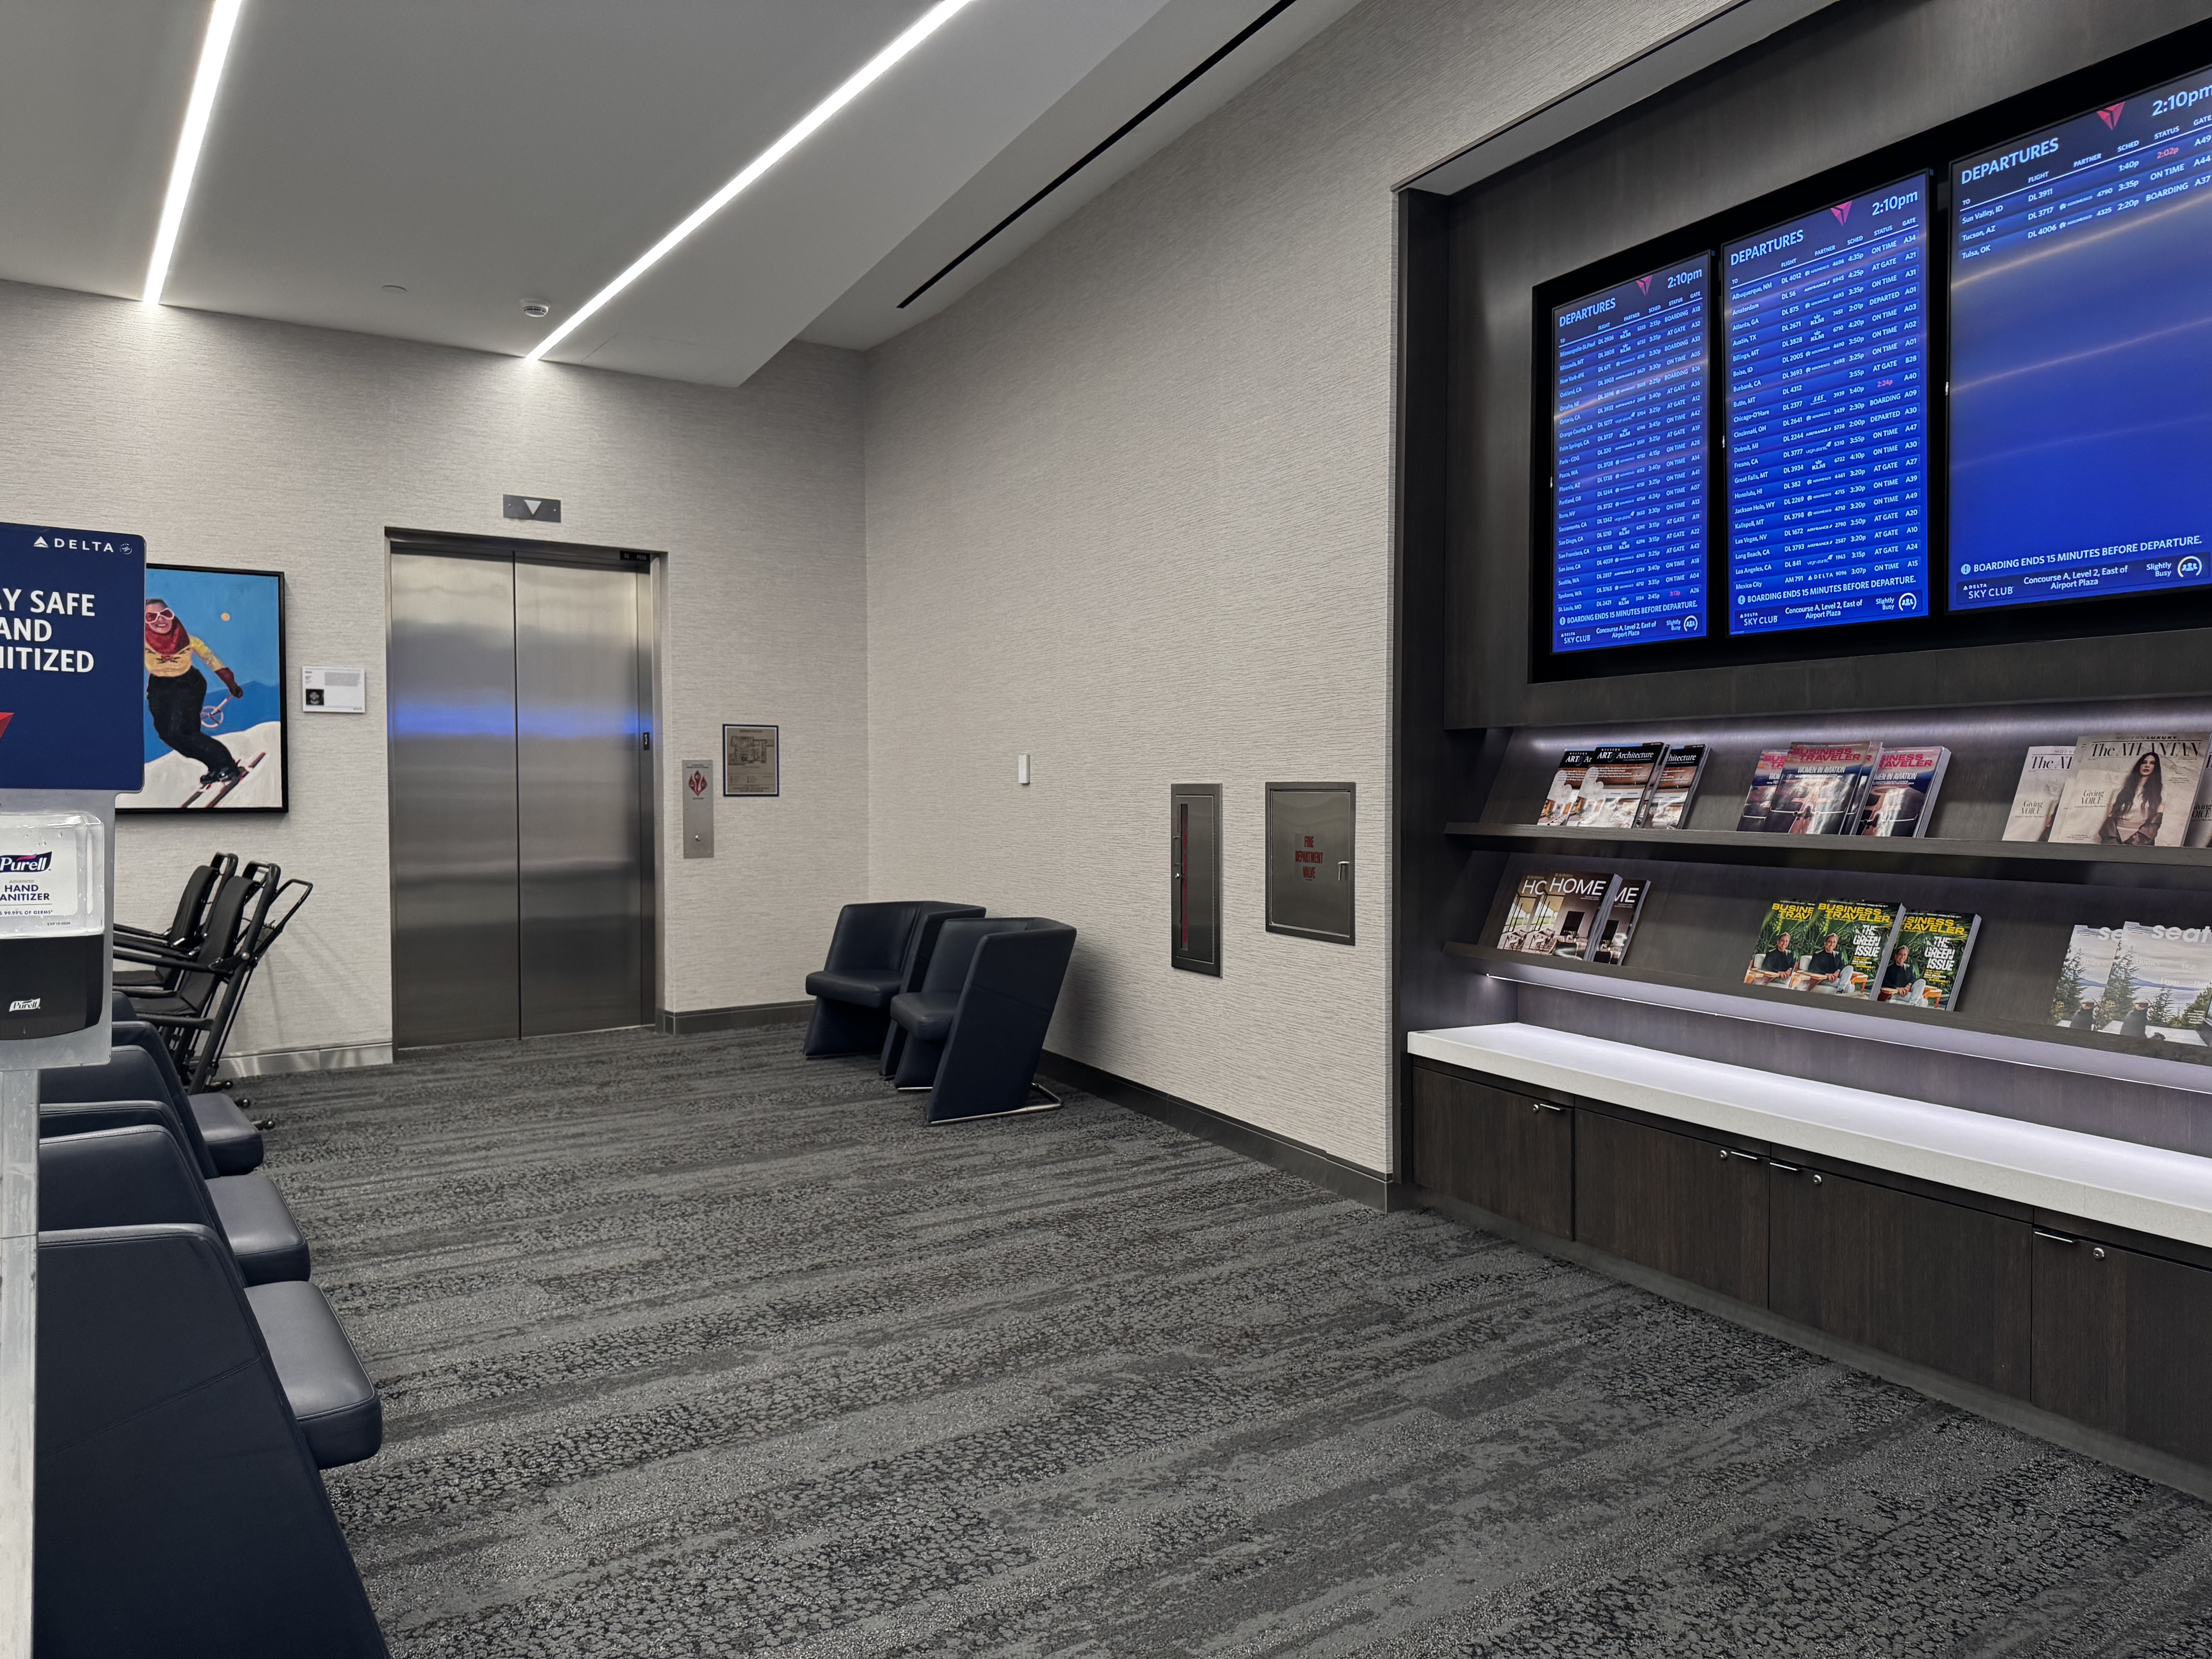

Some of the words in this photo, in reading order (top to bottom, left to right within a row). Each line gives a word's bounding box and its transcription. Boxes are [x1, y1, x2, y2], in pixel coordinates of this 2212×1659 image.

[1962, 137, 2059, 184] DEPARTURES
[2152, 85, 2212, 116] 2:10pm
[2028, 171, 2049, 183] FLIGHT
[2073, 153, 2101, 167] PARTNER
[2117, 140, 2139, 152] SCHED
[2154, 126, 2179, 139] STATUS
[2193, 114, 2212, 125] GATE
[1975, 210, 1994, 219] Valley,
[2028, 193, 2037, 202] DL
[2038, 188, 2053, 198] 3911
[2118, 161, 2139, 171] 1:40p
[2157, 148, 2178, 158] 2:02p
[2194, 135, 2211, 146] A49
[1961, 230, 1985, 241] Tucson,
[1985, 225, 1996, 234] AZ
[2028, 212, 2037, 220] DL
[2038, 206, 2054, 217] 3717
[2096, 187, 2112, 196] 4790
[2118, 180, 2138, 191] 3:35p
[2150, 170, 2162, 180] ON
[2164, 163, 2185, 175] TIME
[2193, 155, 2211, 167] A44
[1961, 250, 1979, 259] Tulsa,
[1980, 244, 1990, 253] OK
[2038, 224, 2056, 234] 4006
[2096, 207, 2112, 216] 4325
[2117, 199, 2139, 210] 2:20p
[2145, 182, 2188, 201] BOARDING
[2194, 175, 2211, 186] A37
[1731, 229, 1803, 266] DEPARTURES
[1872, 191, 1918, 216] 2:10pm
[1781, 258, 1796, 267] FLIGHT
[1815, 245, 1835, 256] PARTNER
[1847, 235, 1863, 245] SCHED
[1874, 225, 1893, 236] STATUS
[1902, 217, 1916, 226] GATE
[1559, 297, 1615, 327] DEPARTURES
[1668, 269, 1702, 288] 2:10pm
[55, 538, 113, 552] DELTA
[1974, 559, 2019, 572] BOARDING
[2021, 555, 2045, 566] ENDS
[2046, 554, 2056, 563] 15
[2057, 548, 2100, 562] MINUTES
[2102, 543, 2138, 556] BEFORE
[2140, 535, 2202, 551] DEPARTURE.
[2146, 562, 2172, 571] Slightly
[2023, 575, 2061, 584] Concourse
[2073, 569, 2091, 579] Level
[2093, 568, 2100, 577] 2,
[2102, 567, 2118, 575] East
[2119, 565, 2128, 573] of
[1747, 592, 1781, 603] BOARDING
[1783, 589, 1800, 598] ENDS
[1810, 584, 1841, 595] MINUTES
[1843, 580, 1869, 591] BEFORE
[1871, 575, 1916, 587] DEPARTURE.
[2050, 580, 2077, 590] Airport
[2078, 578, 2098, 586] Plaza
[1968, 589, 1986, 599] SKY
[1988, 586, 2012, 596] CLUB
[31, 590, 95, 617] SAFE
[1567, 614, 1594, 623] BOARDING
[1594, 612, 1609, 620] ENDS
[1615, 608, 1640, 617] MINUTES
[1641, 605, 1662, 614] BEFORE
[1662, 600, 1697, 611] DEPARTURE.
[2092, 743, 2115, 757] The
[1800, 753, 1861, 762] TRAVELER
[2032, 756, 2053, 769] The
[2083, 789, 2104, 798] Giving
[2023, 800, 2043, 808] Giving
[0, 857, 47, 871] Purell
[1295, 850, 1323, 864] DEPARTMENT
[1549, 878, 1606, 895] HOME
[1818, 903, 1882, 915] BUSINESS
[1825, 910, 1890, 923] TRAVELER
[1862, 924, 1878, 936] THE
[1853, 935, 1881, 946] GREEN
[1934, 936, 1951, 948] THE
[1855, 945, 1880, 957] ISSUE
[1924, 946, 1955, 960] GREEN
[1927, 958, 1955, 971] ISSUE
[13, 1000, 38, 1010] Purell
